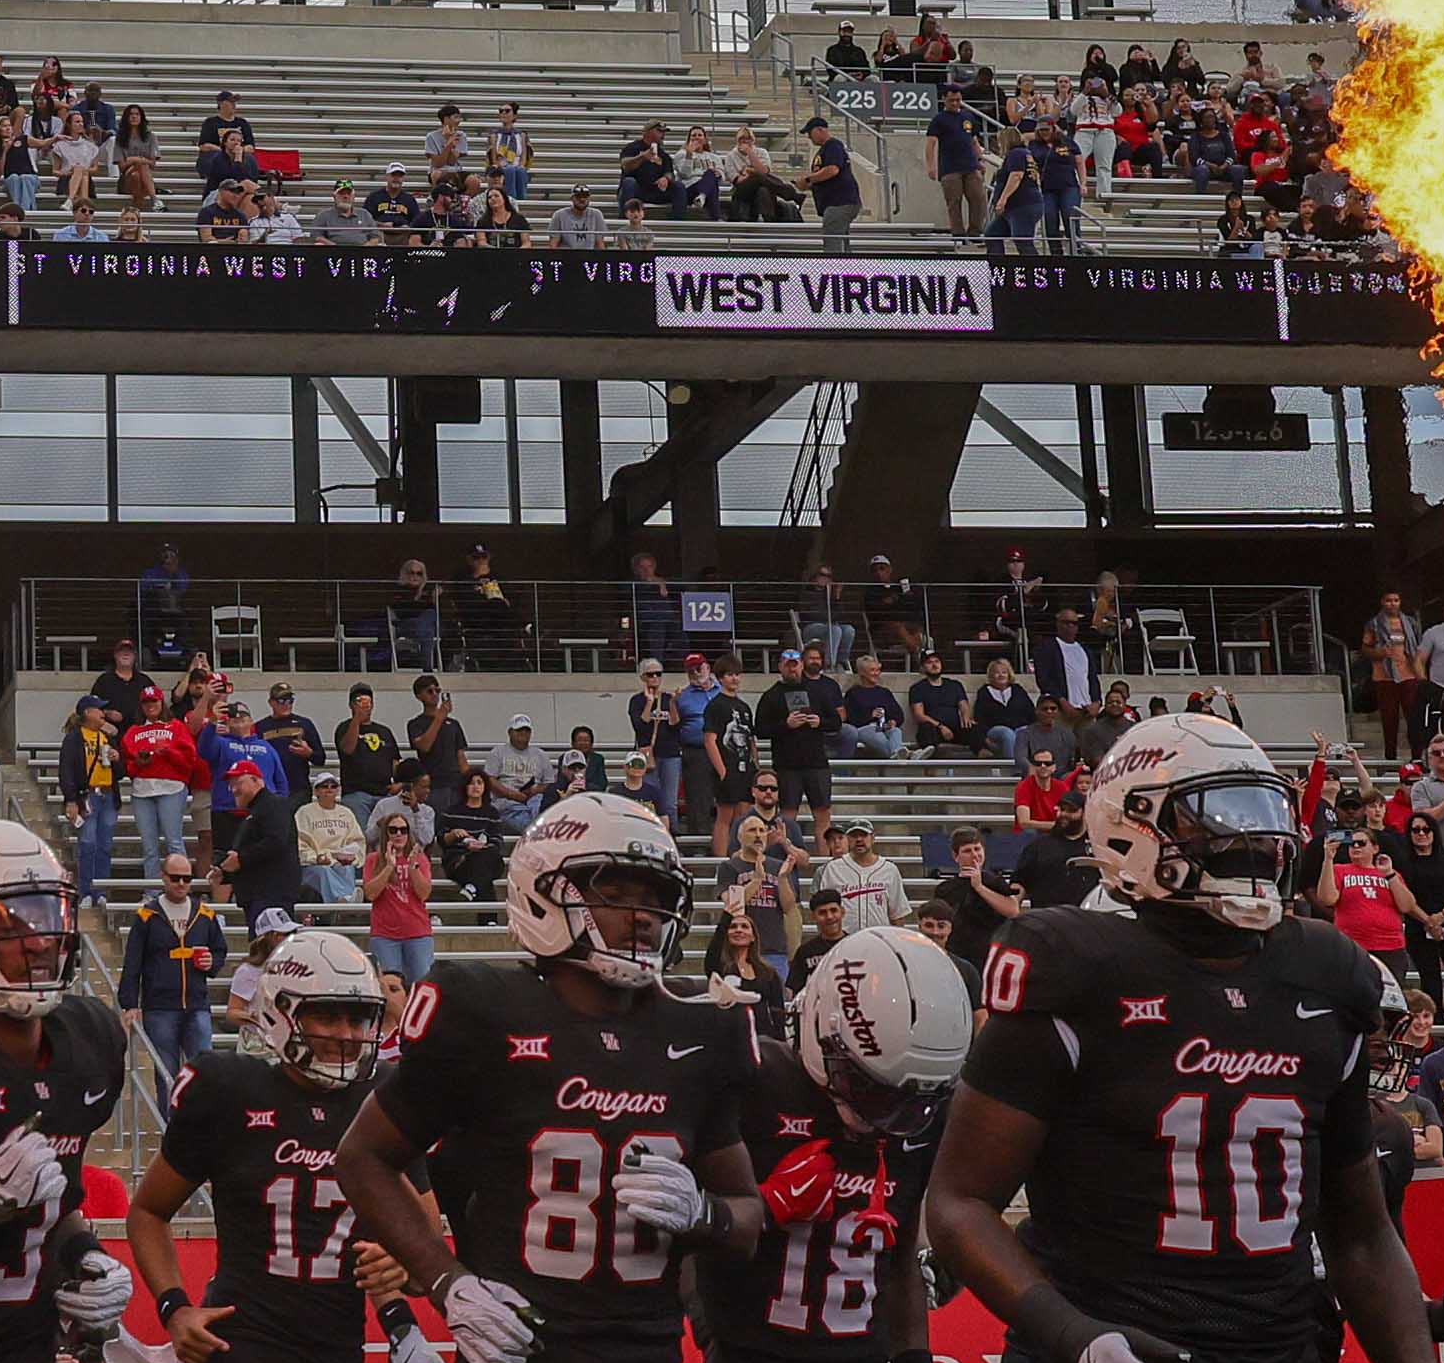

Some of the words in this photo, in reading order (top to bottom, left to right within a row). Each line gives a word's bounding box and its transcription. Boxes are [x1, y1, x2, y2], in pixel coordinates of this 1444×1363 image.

[836, 90, 876, 110] 225
[891, 92, 931, 112] 226
[68, 253, 211, 278] VIRGINIA
[223, 255, 306, 279] WEST
[989, 266, 1066, 290] WEST
[1086, 267, 1224, 291] VIRGINIA
[665, 272, 791, 314] WEST
[799, 272, 979, 315] VIRGINIA
[687, 600, 727, 624] 125
[311, 818, 350, 830] HOUSTON
[833, 958, 883, 1058] Houston
[1173, 1036, 1304, 1087] Cougars
[555, 1076, 670, 1120] Cougars
[1155, 1091, 1309, 1257] 10
[264, 1173, 360, 1281] 17
[767, 1210, 882, 1337] 18
